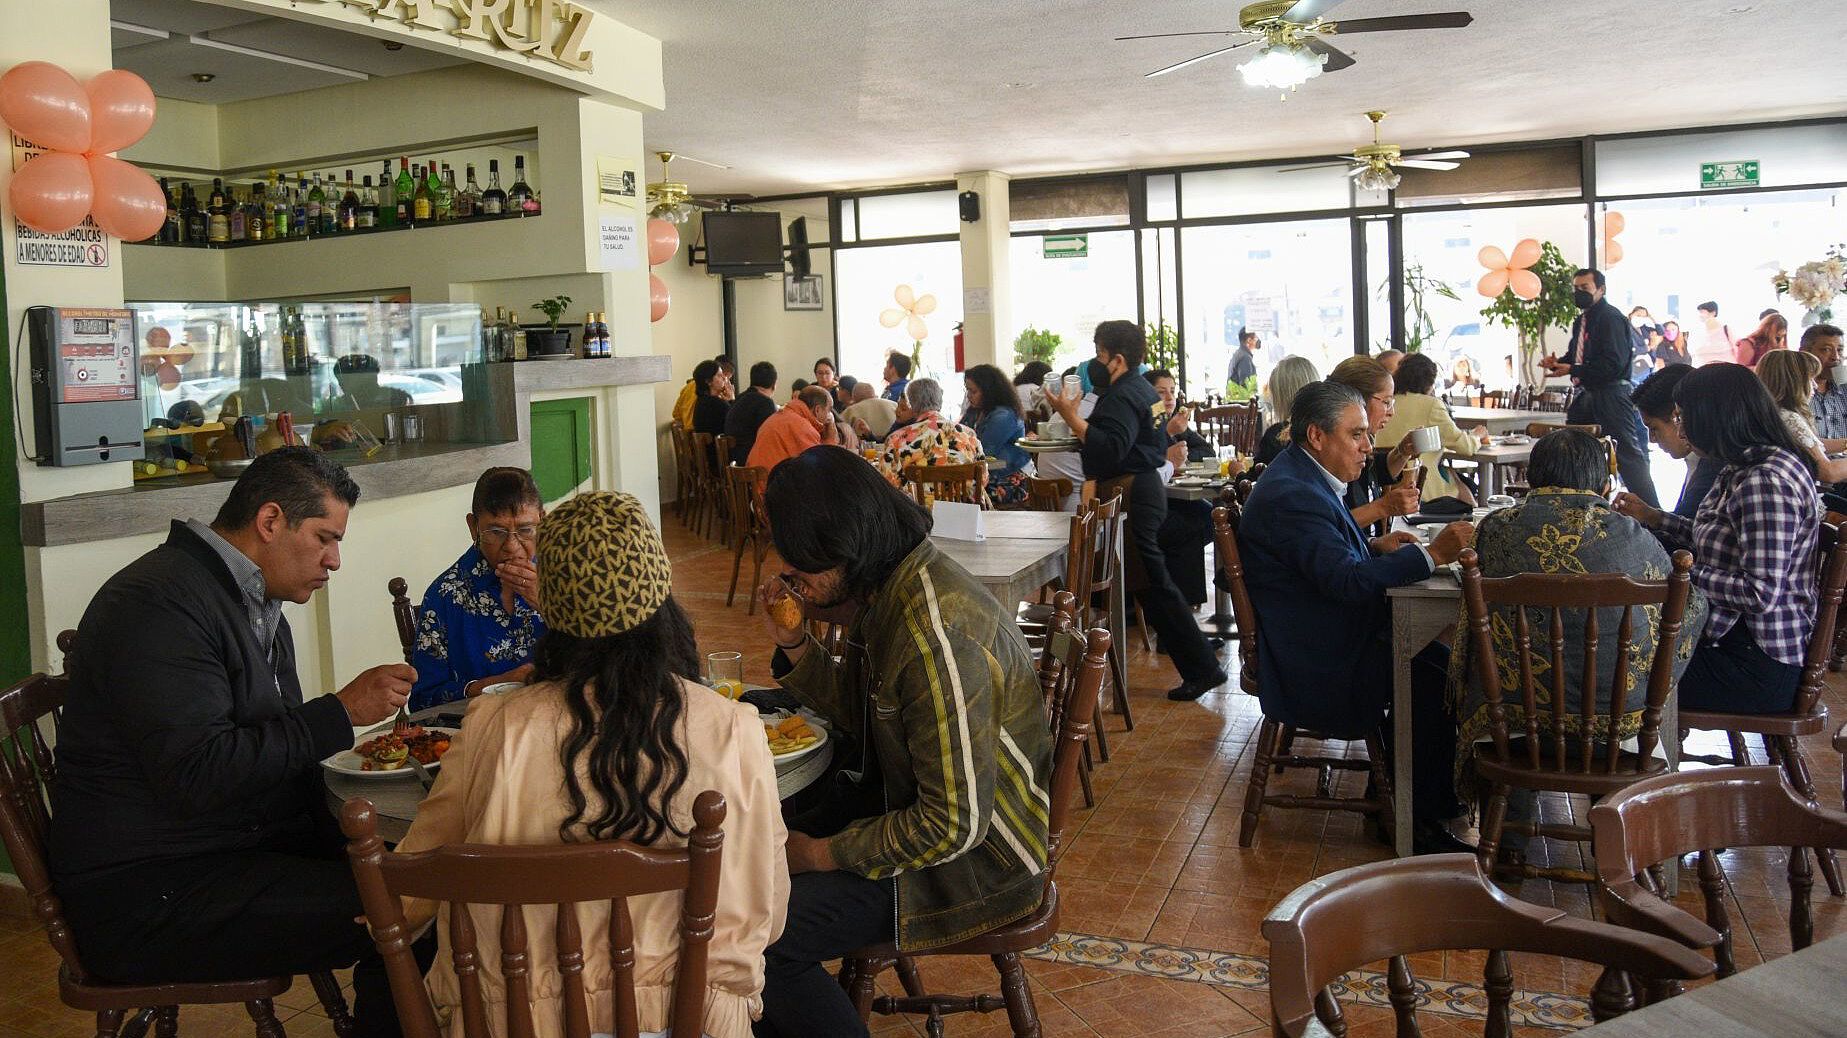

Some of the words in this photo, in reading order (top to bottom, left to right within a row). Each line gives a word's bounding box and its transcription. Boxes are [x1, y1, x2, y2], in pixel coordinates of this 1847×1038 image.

[19, 242, 25, 261] A
[25, 242, 57, 262] MENORES
[58, 244, 67, 263] DE
[68, 244, 86, 264] EDAD
